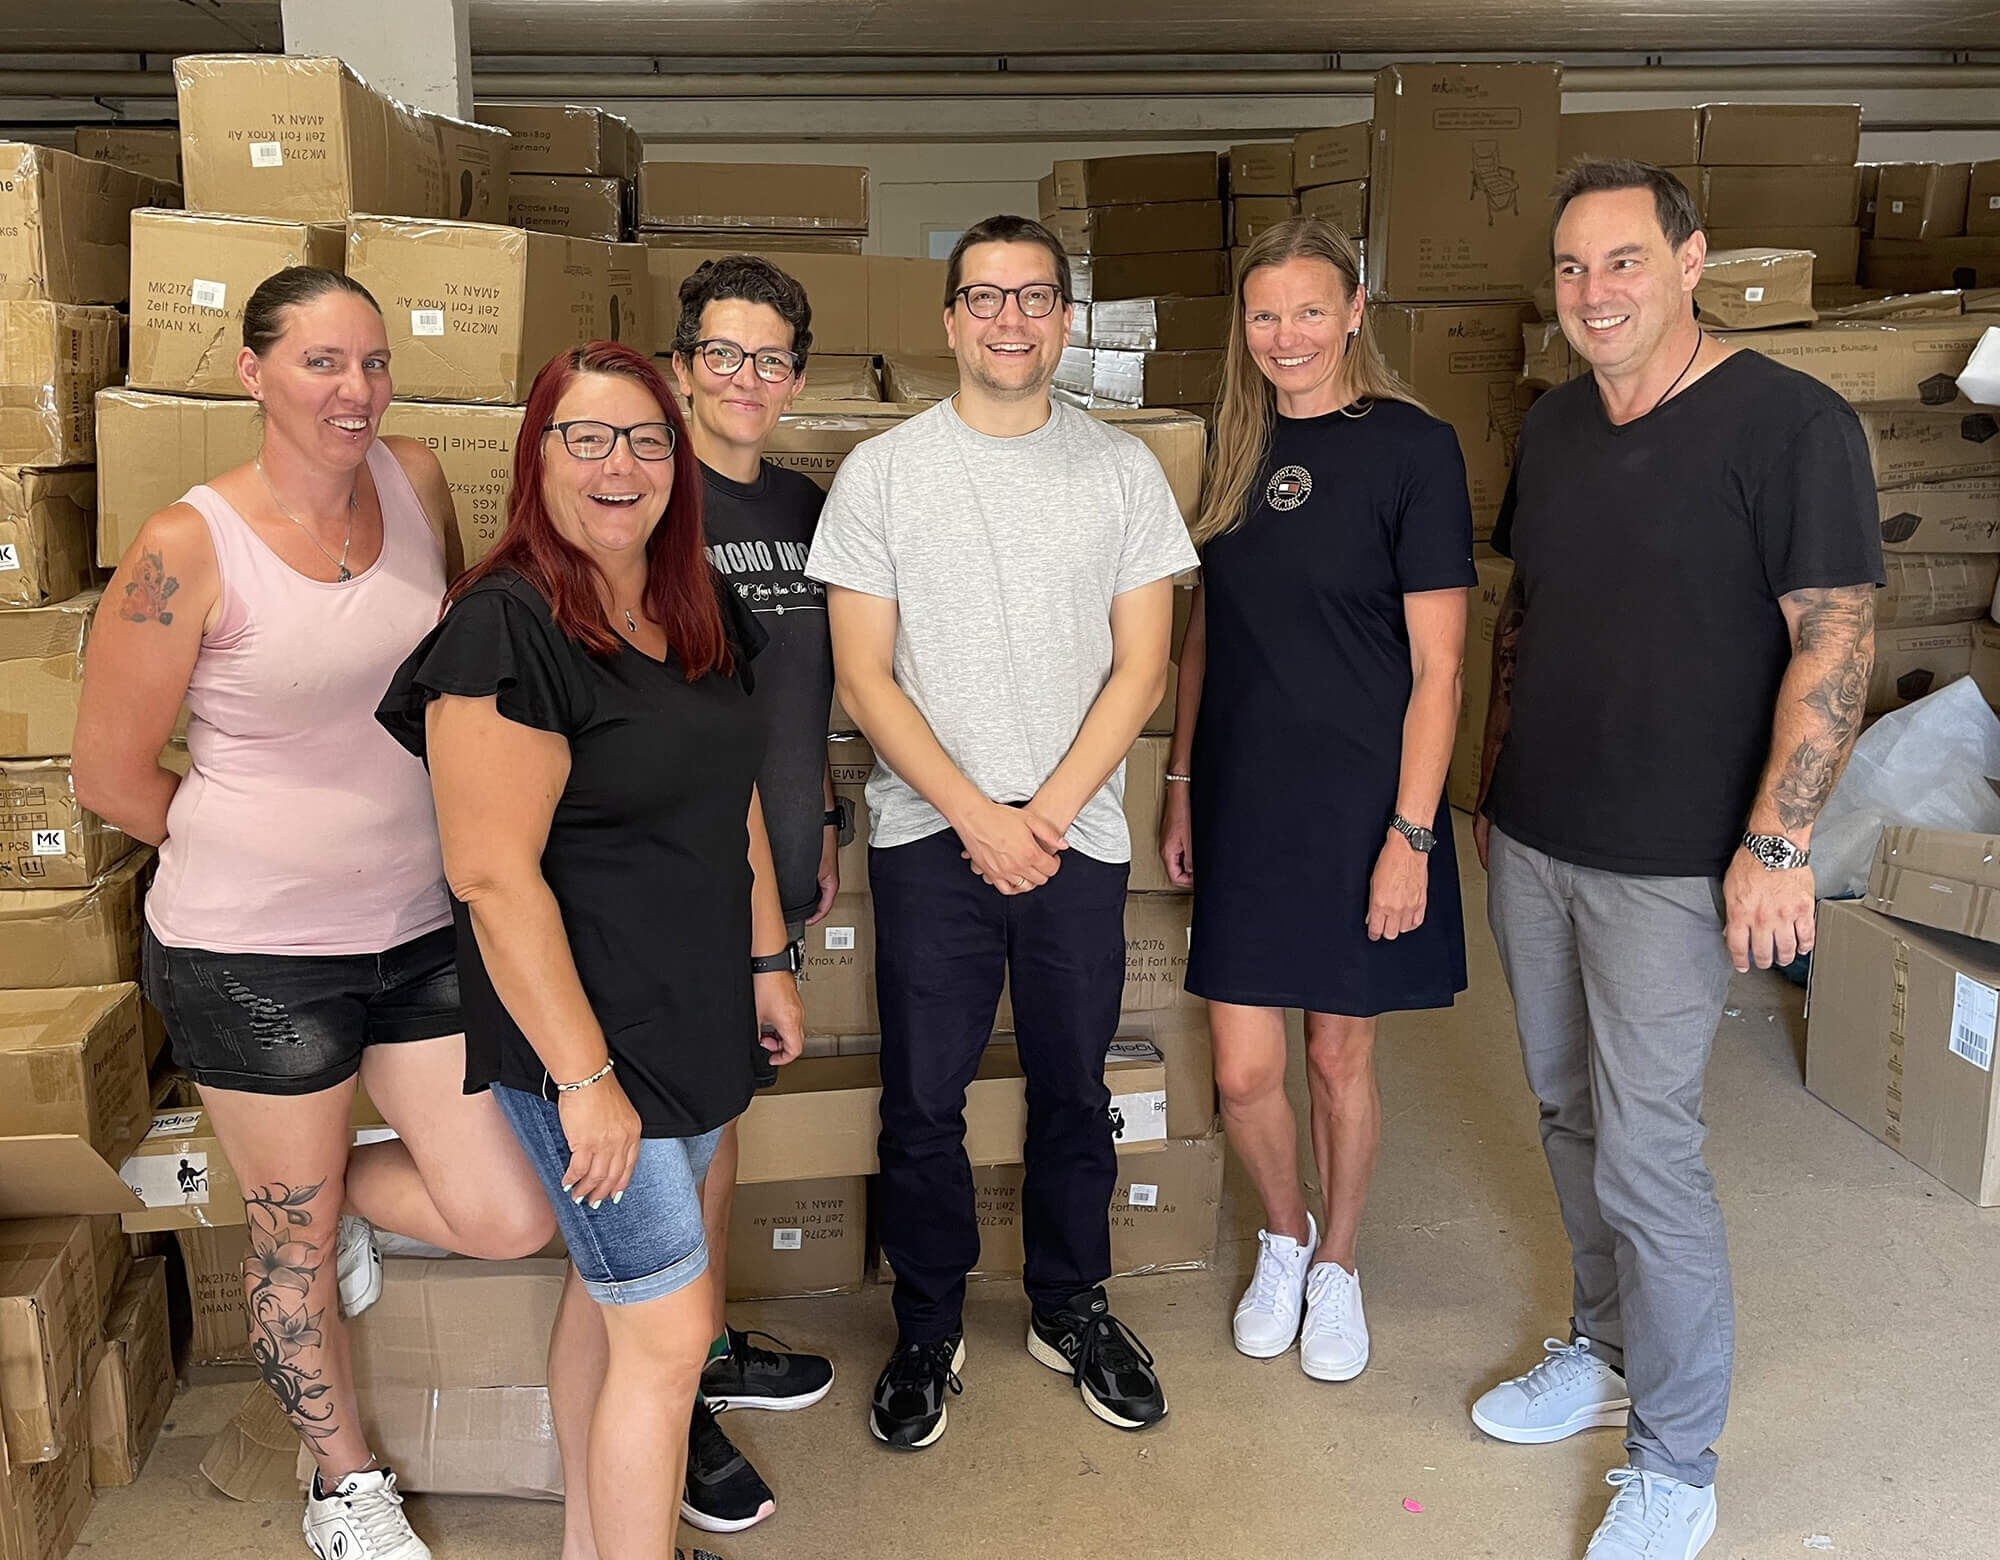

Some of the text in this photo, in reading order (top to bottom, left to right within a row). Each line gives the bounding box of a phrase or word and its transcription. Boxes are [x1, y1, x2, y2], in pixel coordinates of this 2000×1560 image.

[271, 113, 325, 125] 4MAN XL
[247, 130, 276, 142] Knox
[283, 148, 326, 160] MK2176
[148, 281, 193, 297] MK2176
[444, 283, 500, 299] 4MAN XL
[397, 296, 412, 308] Air
[417, 298, 446, 312] Knox
[200, 305, 230, 319] Knox
[146, 317, 202, 334] 4MAN XL
[453, 320, 498, 335] MK2176
[451, 438, 510, 452] Tackle
[448, 482, 505, 495] 165x25x2
[472, 498, 497, 510] KGS
[472, 513, 497, 525] KGS
[478, 528, 495, 540] PC
[832, 769, 855, 780] Ma
[37, 832, 61, 847] MK
[8, 841, 30, 852] PCS
[808, 955, 853, 966] Knox Air
[1161, 972, 1174, 982] XL
[795, 1200, 807, 1210] XL
[772, 1215, 798, 1225] Knox
[1123, 1217, 1135, 1227] XL
